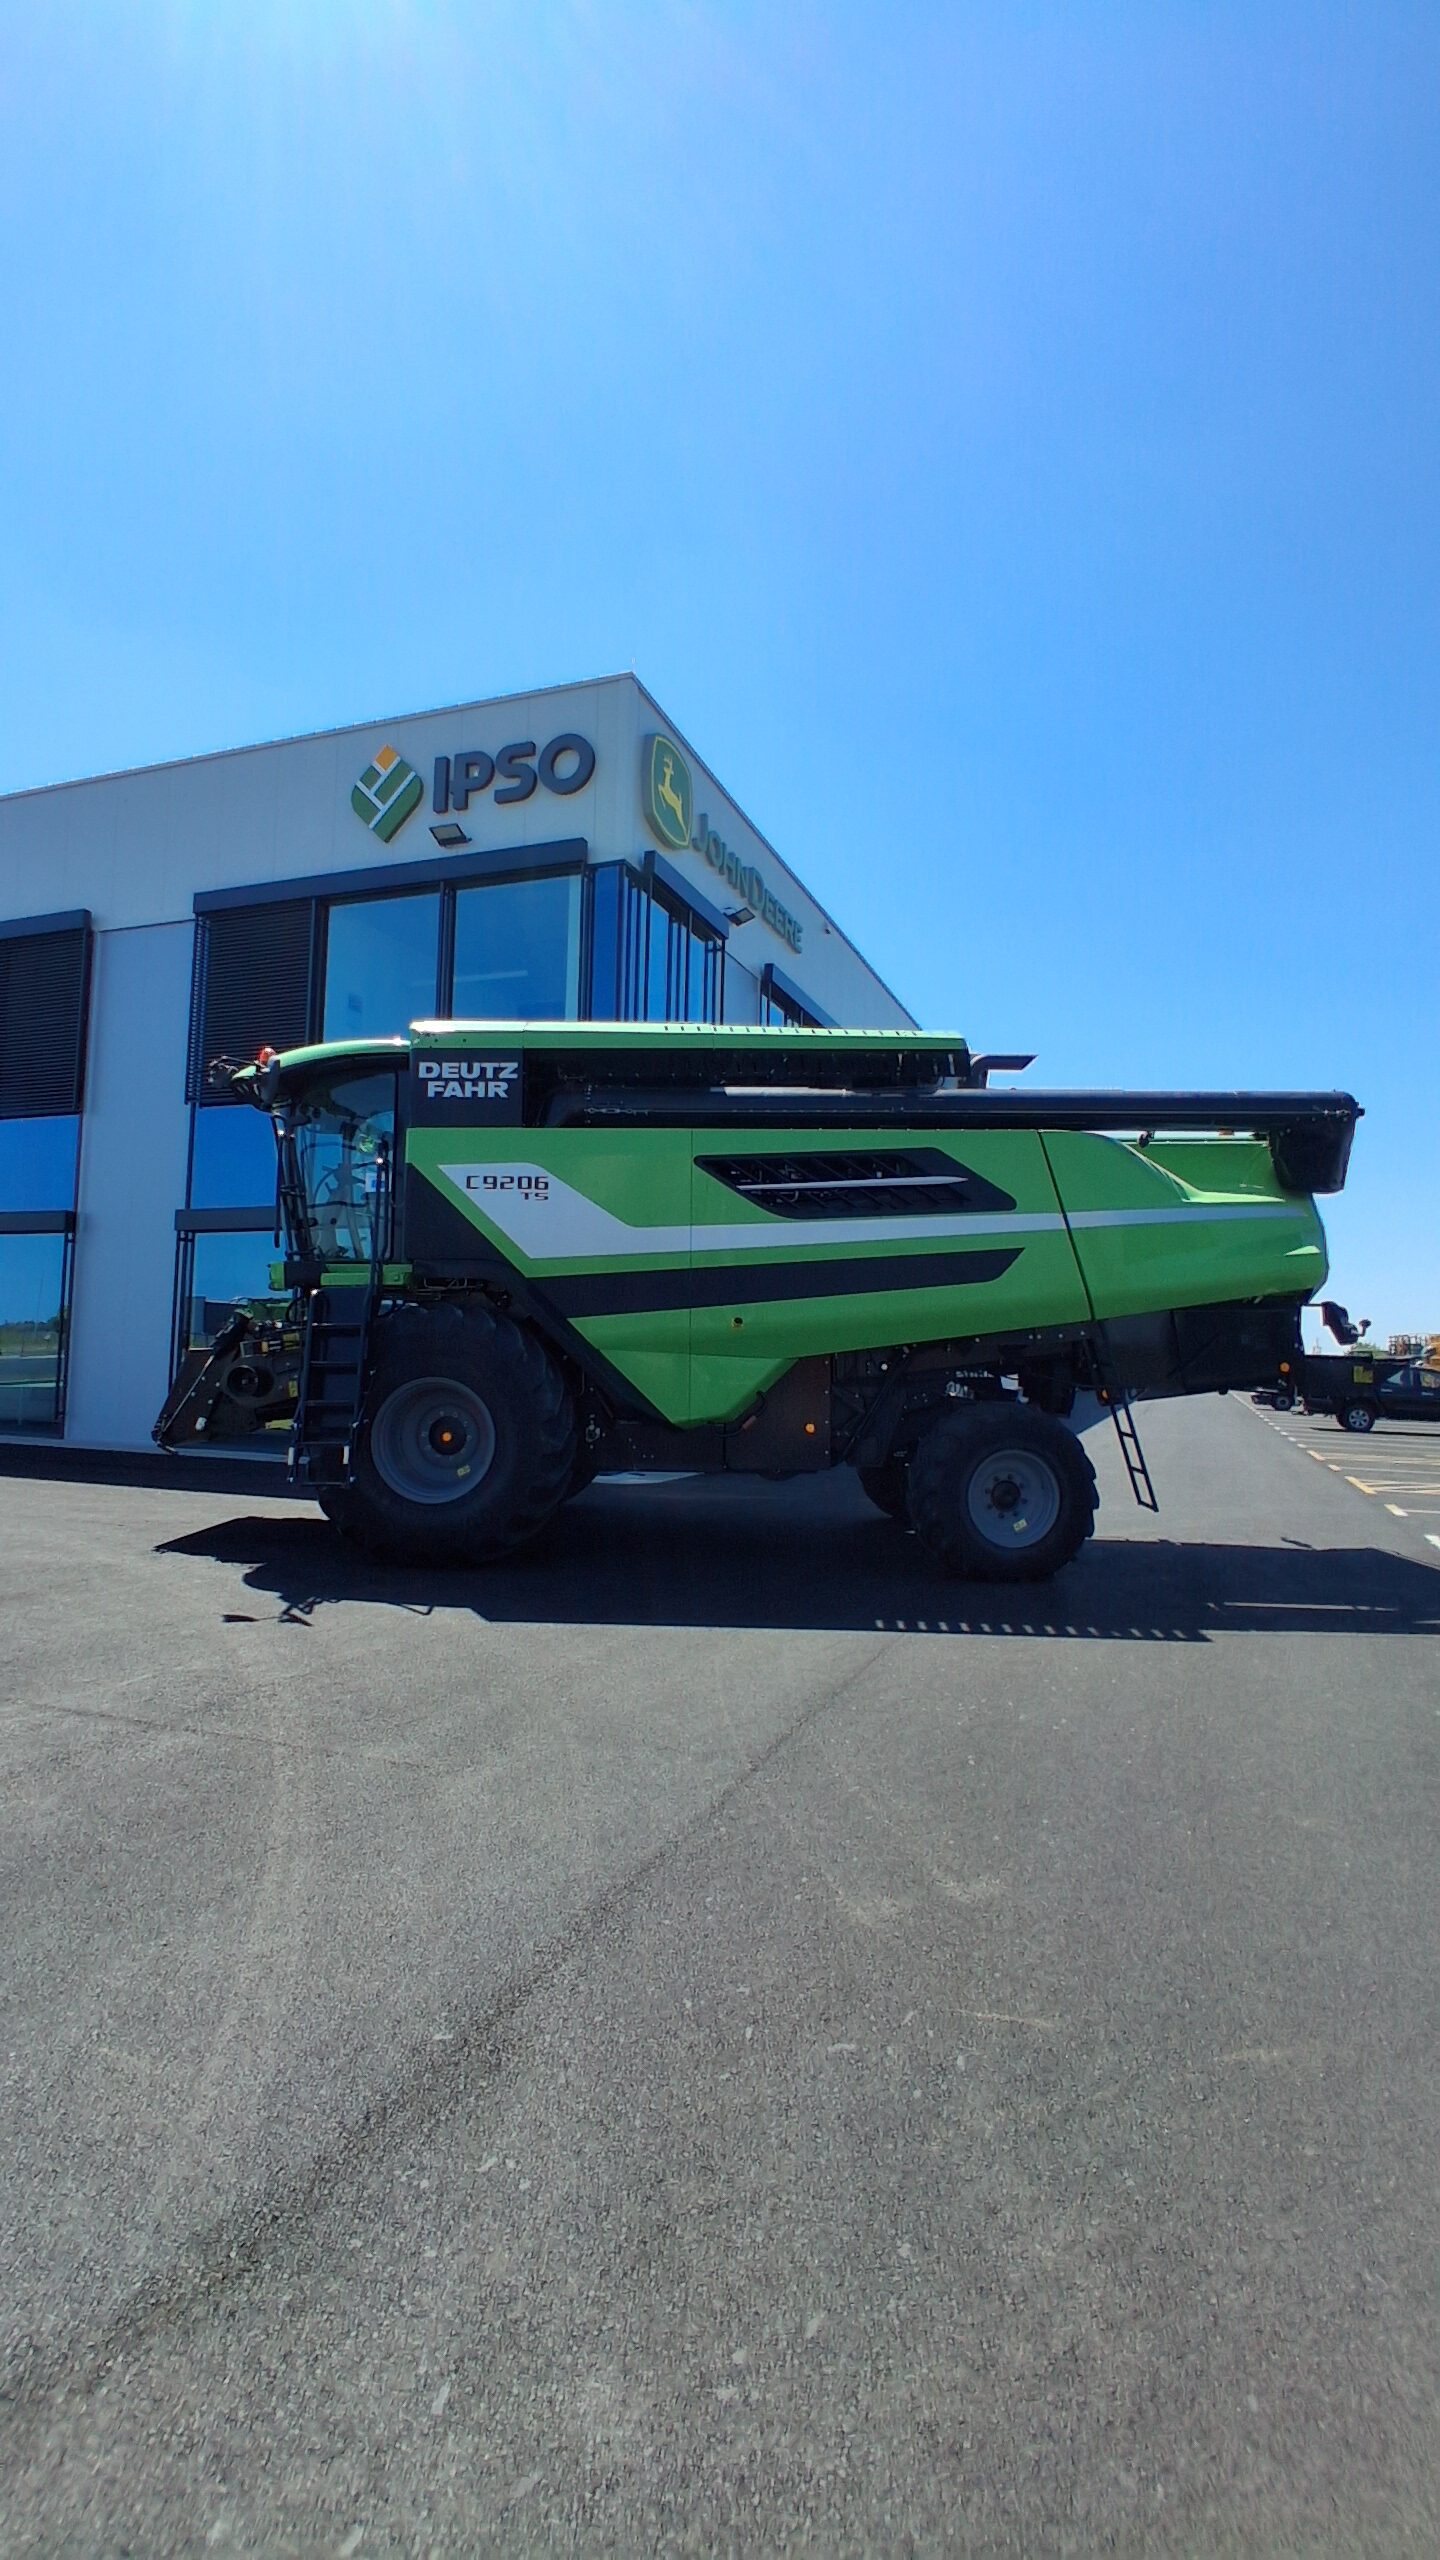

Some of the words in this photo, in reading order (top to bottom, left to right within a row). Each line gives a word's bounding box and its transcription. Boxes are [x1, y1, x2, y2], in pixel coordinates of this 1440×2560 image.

[433, 733, 596, 813] IPSO
[418, 1062, 518, 1079] DEUTZ
[427, 1081, 509, 1098] FAHR
[466, 1175, 549, 1190] C9206
[520, 1191, 549, 1201] TS
